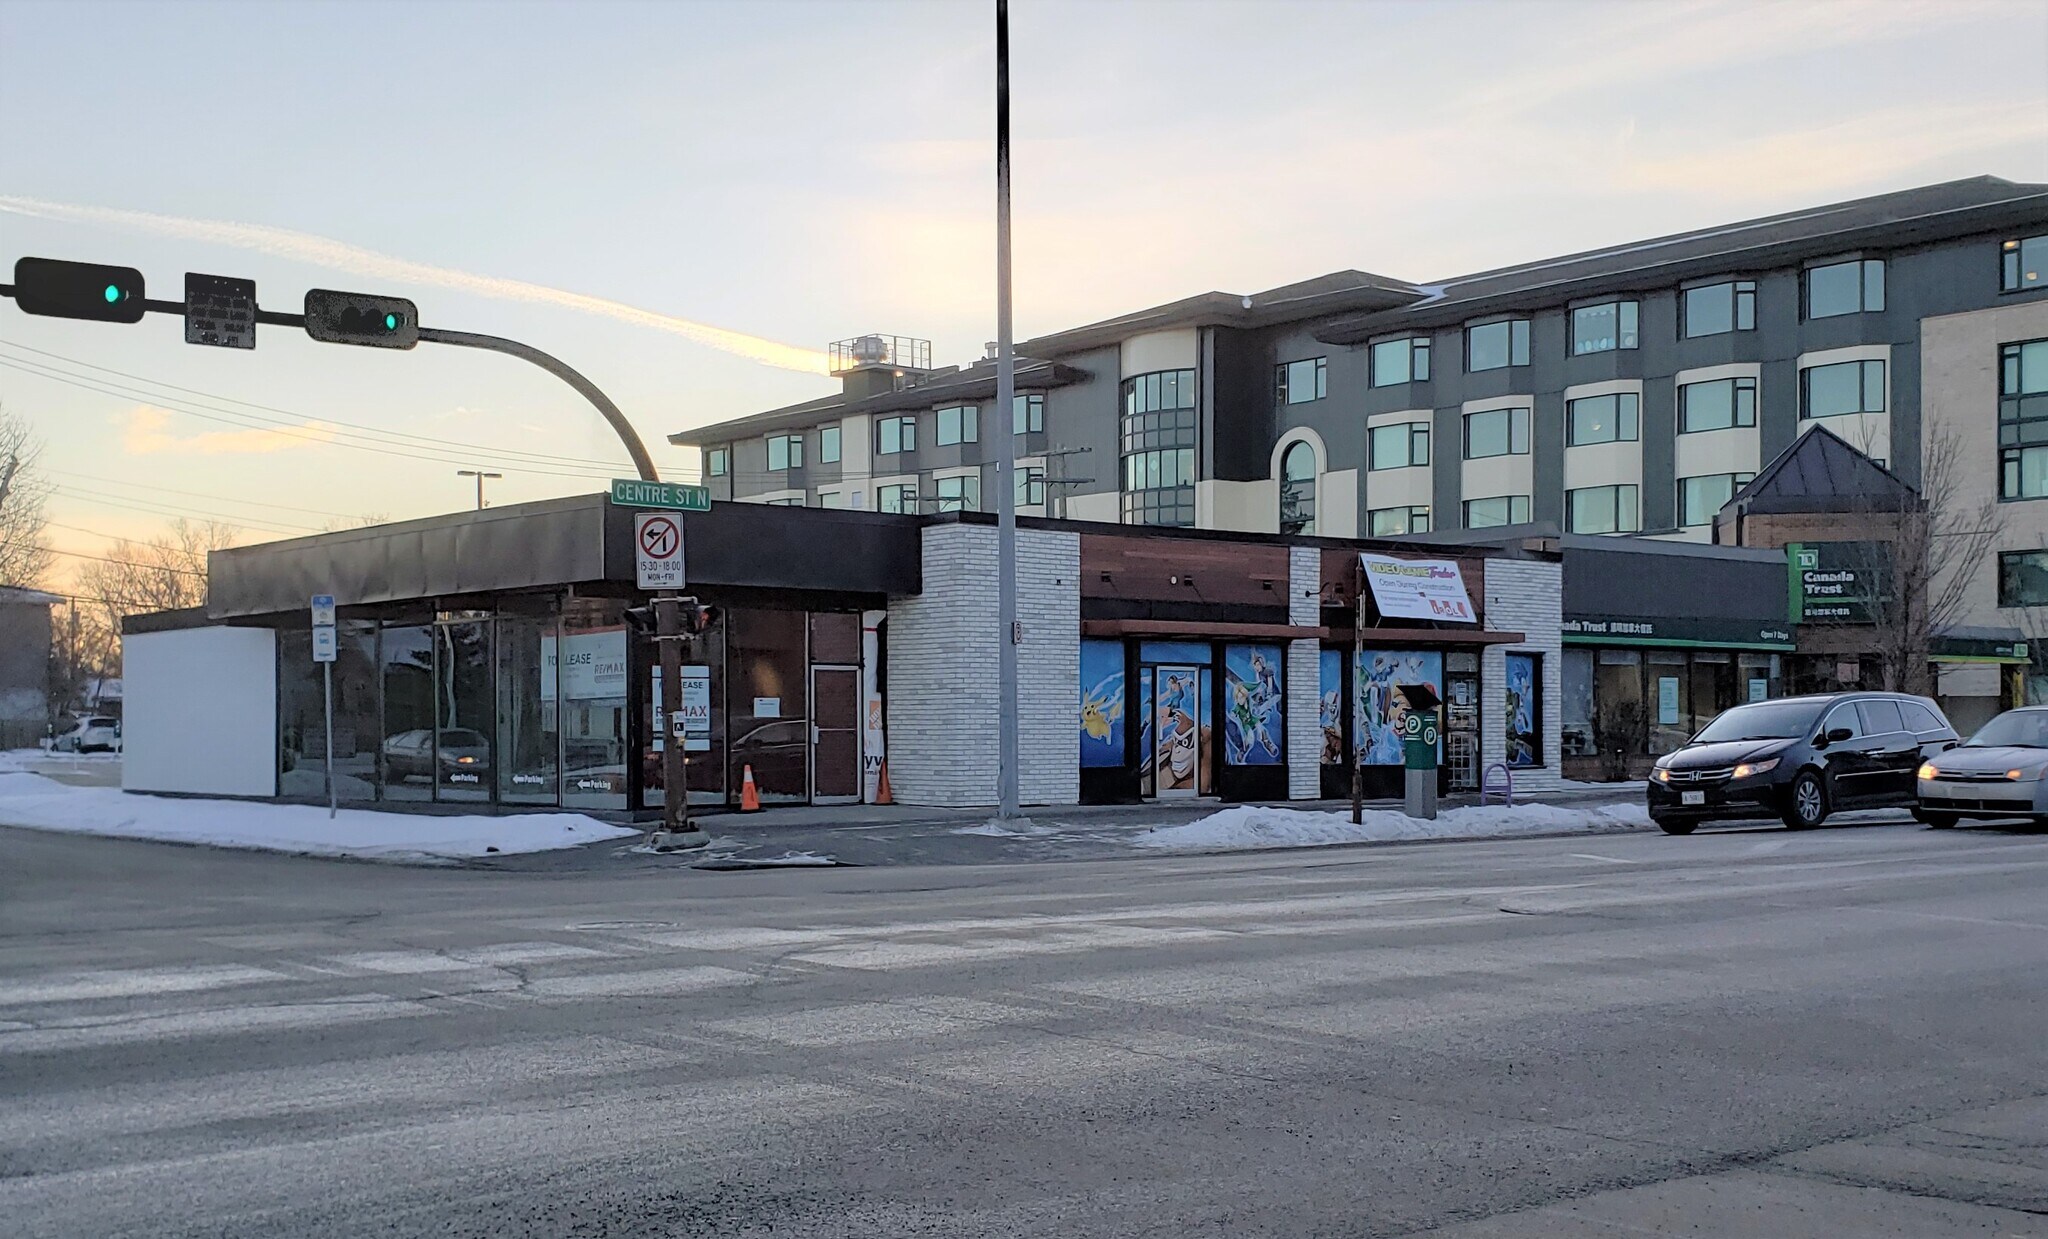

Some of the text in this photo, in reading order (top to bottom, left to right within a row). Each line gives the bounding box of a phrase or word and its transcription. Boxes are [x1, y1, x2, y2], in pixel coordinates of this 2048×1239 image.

[616, 483, 706, 506] CENTRE ST N
[1797, 553, 1816, 566] TD
[1804, 571, 1854, 582] Canada
[1804, 584, 1843, 594] Trust
[1582, 621, 1607, 632] Trust
[565, 653, 591, 665] LEASE
